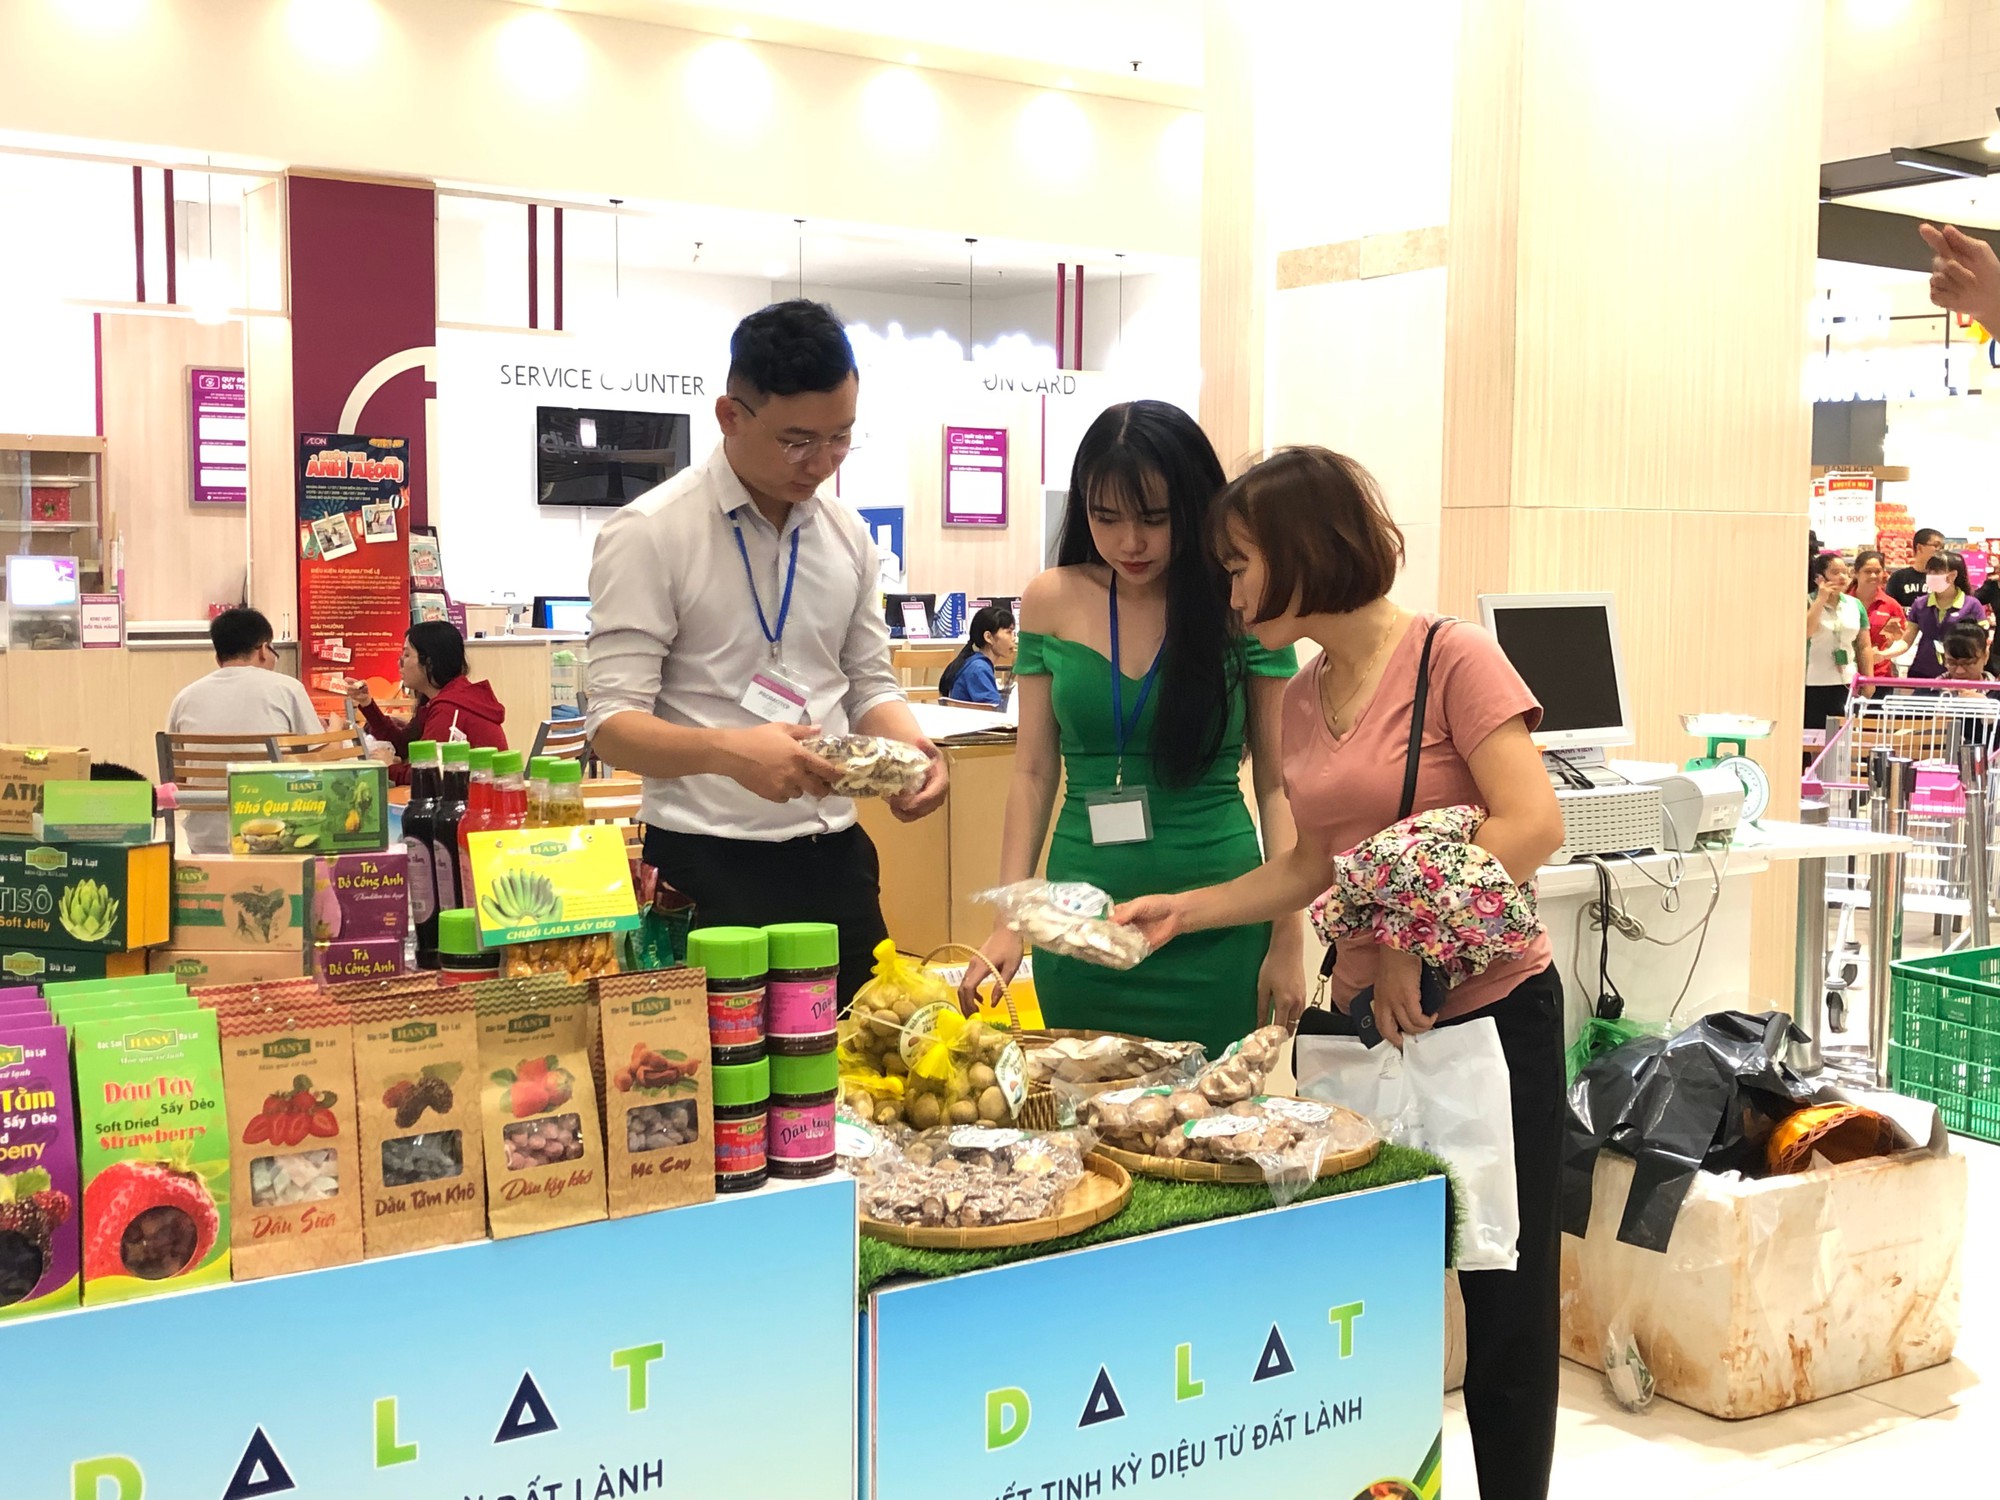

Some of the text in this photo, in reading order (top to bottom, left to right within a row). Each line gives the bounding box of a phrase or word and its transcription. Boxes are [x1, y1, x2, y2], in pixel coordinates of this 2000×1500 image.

[500, 365, 592, 389] SERVICE
[1904, 583, 1920, 594] SAI
[2, 782, 44, 801] ATIS
[290, 782, 319, 791] HANY
[262, 800, 289, 817] Qua
[533, 844, 565, 854] HANY
[354, 875, 380, 890] Công
[382, 873, 404, 886] Anh
[24, 918, 51, 932] Jelly
[344, 962, 371, 977] Công
[373, 960, 395, 973] Anh
[130, 1034, 171, 1049] HANY
[160, 1098, 216, 1115] Sấy Dẻo
[3, 1112, 57, 1130] Sấy Dẻo
[95, 1116, 160, 1135] Soft Dried
[100, 1125, 207, 1151] Strawberry
[985, 1300, 1364, 1452] DALAT
[1041, 1468, 1101, 1500] TINH
[1111, 1453, 1142, 1491] KỲ
[1151, 1438, 1206, 1480] DIỆU
[1214, 1424, 1247, 1461] TỪ
[1251, 1408, 1298, 1451] ĐẤT
[1304, 1396, 1363, 1436] LÀNH
